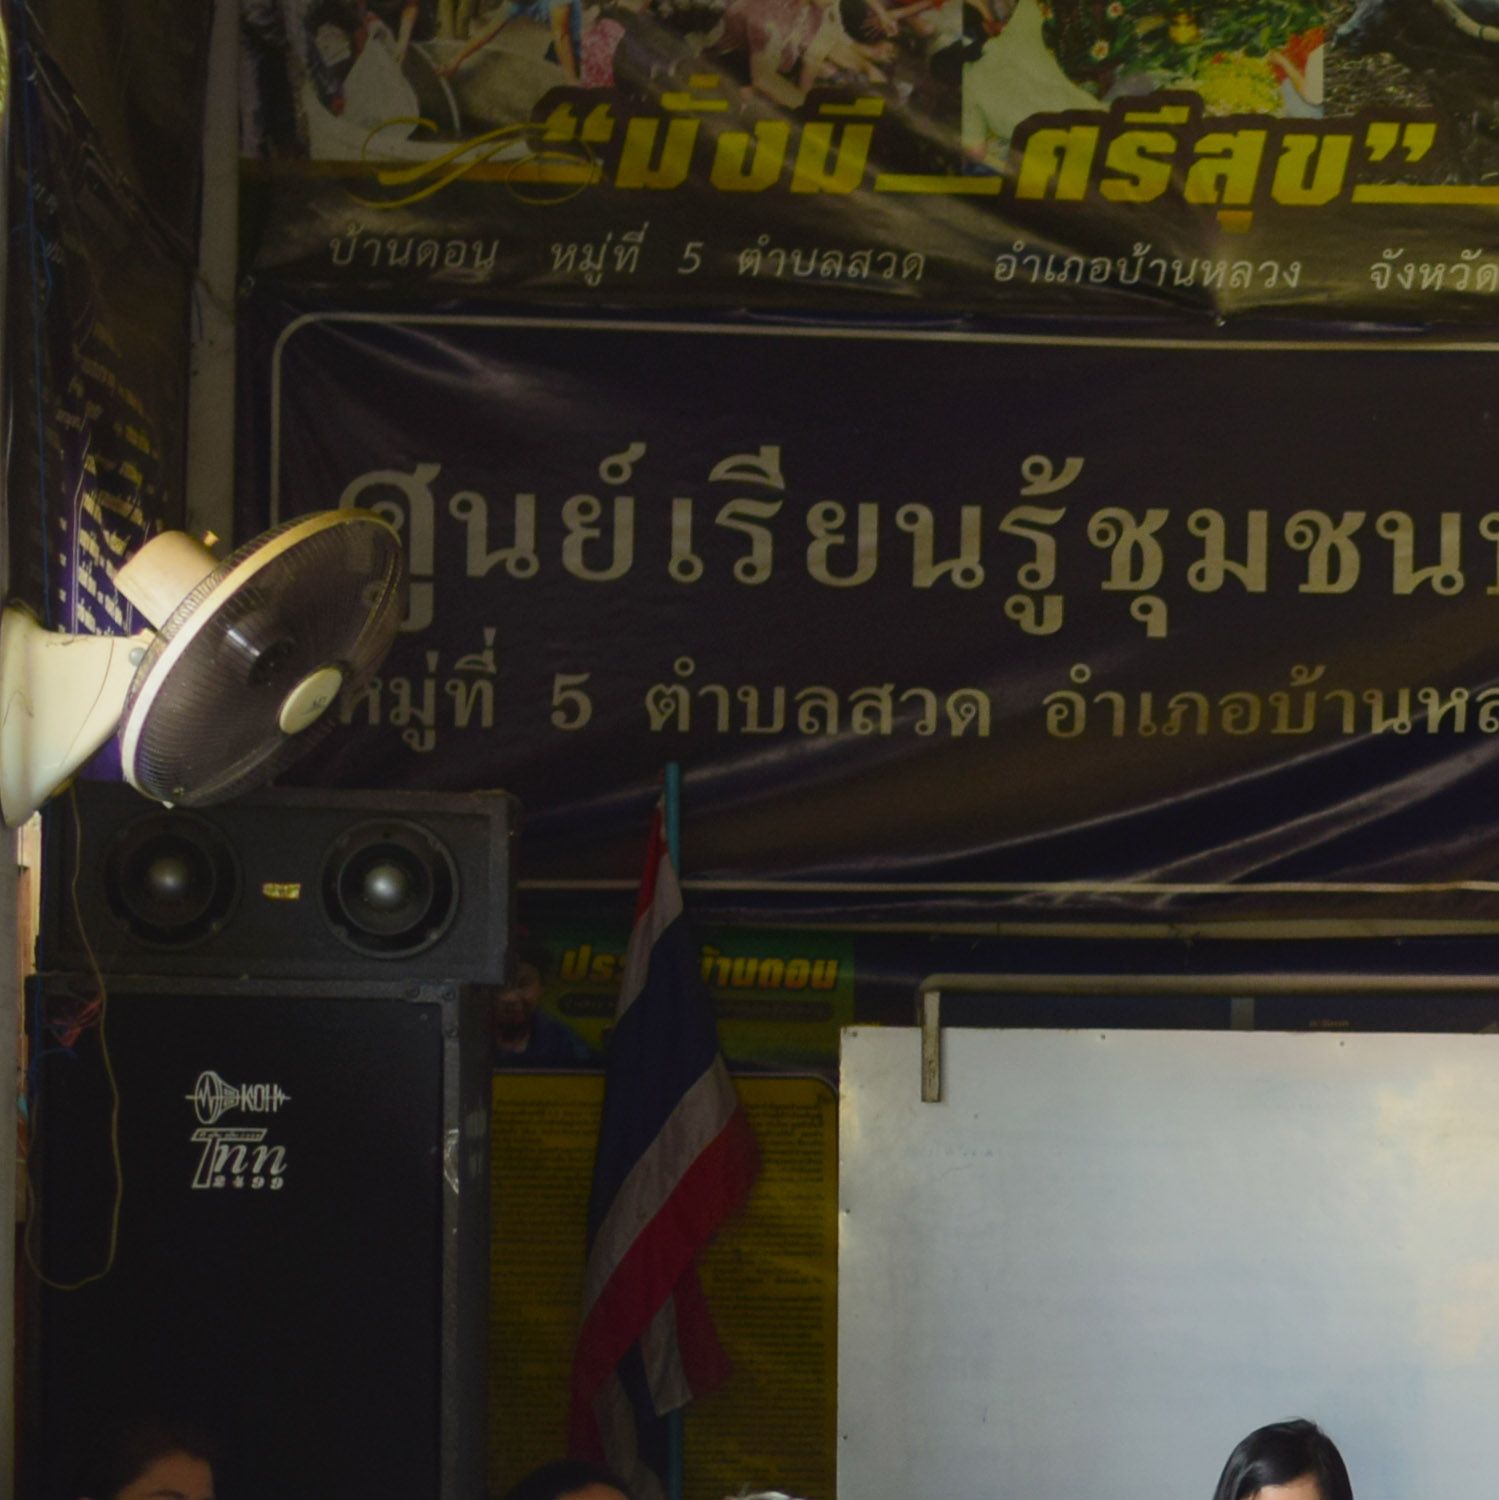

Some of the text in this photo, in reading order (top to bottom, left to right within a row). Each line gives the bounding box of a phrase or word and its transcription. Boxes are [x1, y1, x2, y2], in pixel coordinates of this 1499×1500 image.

[328, 225, 499, 276] บ้านดอน
[550, 222, 650, 288] หมู่ที่
[677, 239, 701, 275] 5
[738, 233, 926, 283] ตำบลสวด
[994, 239, 1302, 293] อำเภอบ้านหลวง
[340, 629, 497, 752] หมู่ที่
[550, 675, 593, 730] 5
[645, 655, 992, 736] ตำบลสวด
